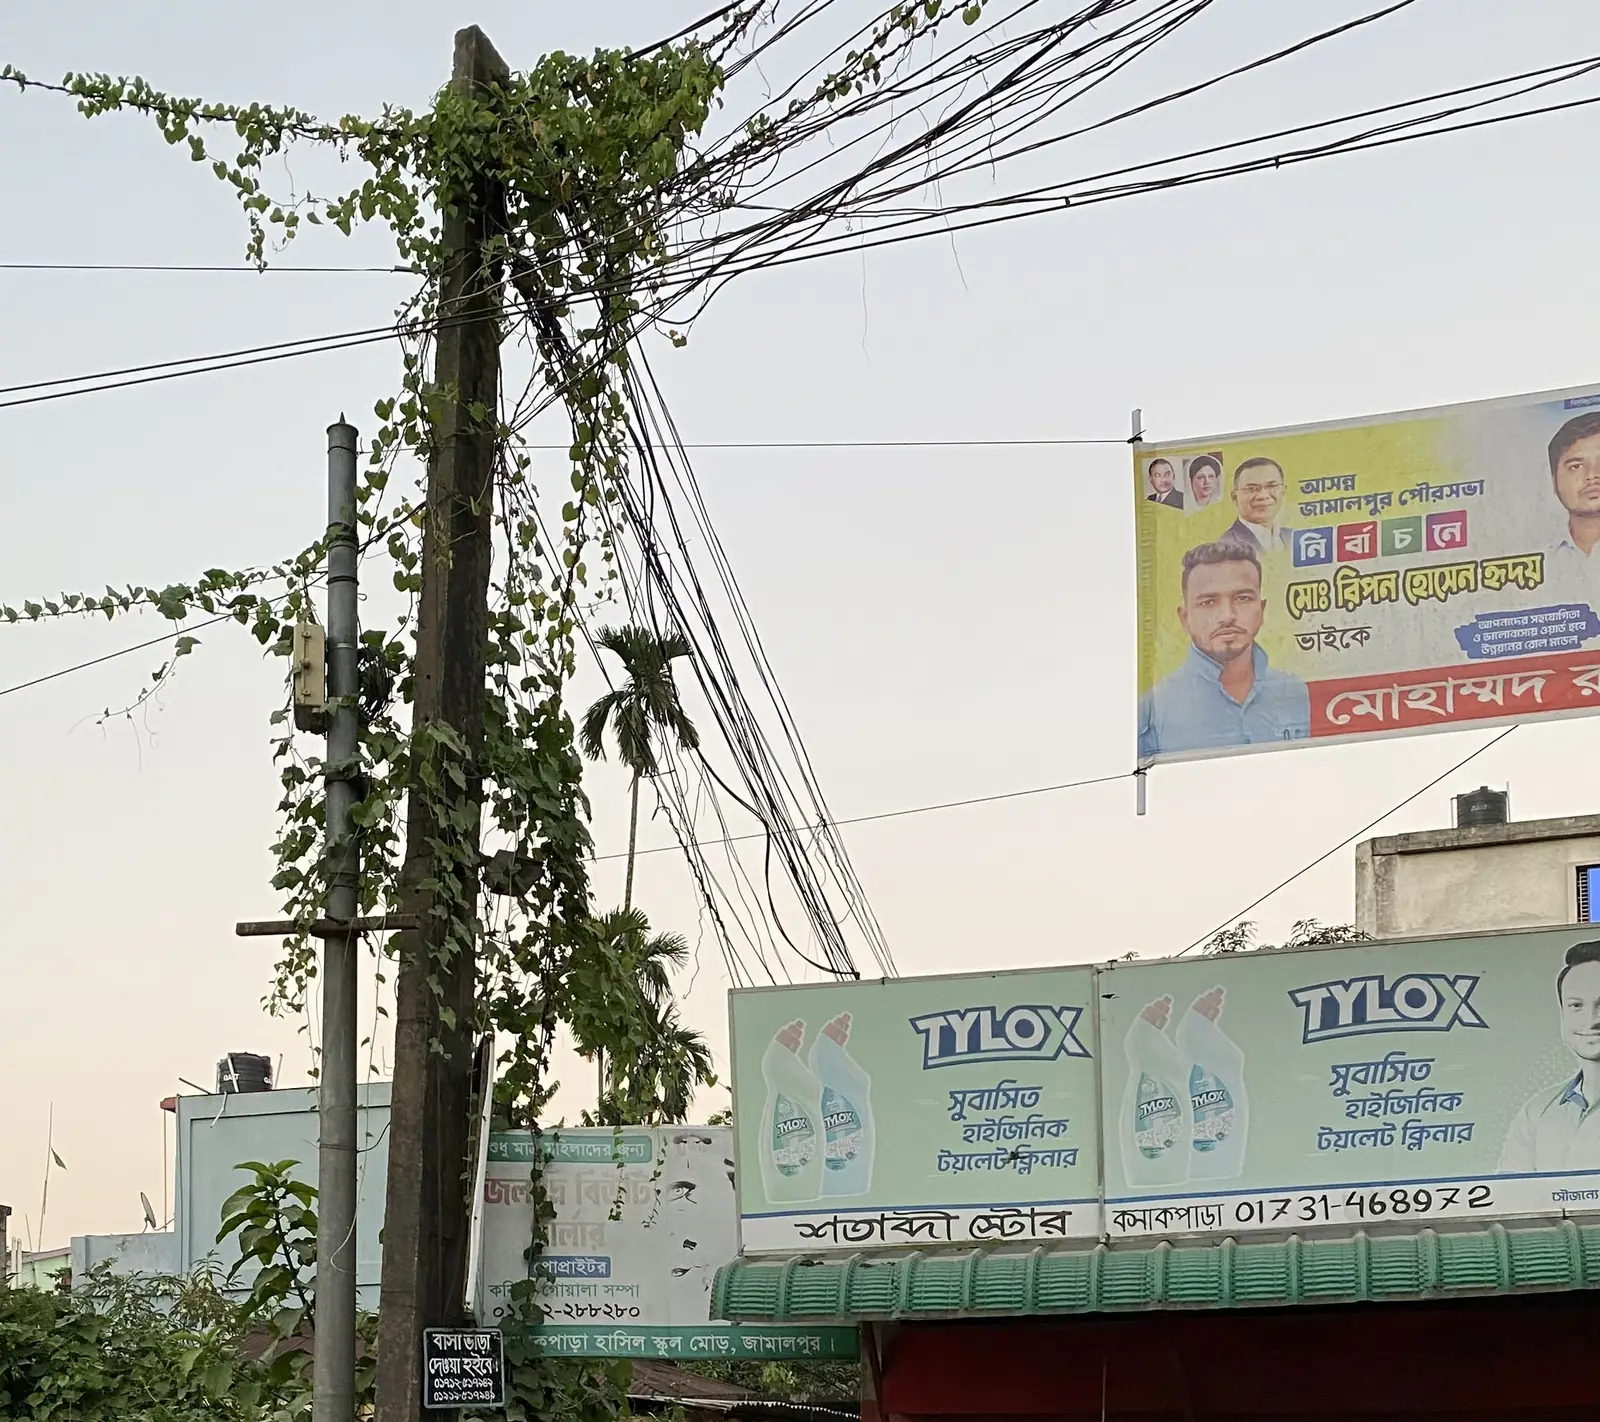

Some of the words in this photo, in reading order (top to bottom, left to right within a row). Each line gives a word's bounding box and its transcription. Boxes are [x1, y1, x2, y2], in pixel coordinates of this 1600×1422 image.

[1298, 474, 1357, 495] আসন্ন
[1298, 491, 1394, 517] জামালপুর
[1398, 479, 1485, 506] পৌরসভা
[1286, 579, 1332, 620] মোঃ
[1334, 564, 1400, 613] রিপন
[1403, 560, 1479, 607] হোসেন
[1480, 553, 1545, 591] হৃদয়
[1294, 623, 1373, 653] ভাইকে
[1478, 615, 1529, 630] আপনাদের
[1568, 621, 1587, 633] হবে
[1524, 637, 1548, 650] রোল
[1326, 668, 1557, 726] মোহাম্মদ
[1288, 972, 1490, 1044] TYLOX
[908, 1004, 1093, 1070] TYLOX
[1328, 1051, 1436, 1098] সুবাসিত
[947, 1079, 1043, 1122] সুবাসিত
[1345, 1087, 1464, 1119] হাইজিনিক
[962, 1114, 1070, 1144] হাইজিনিক
[1317, 1121, 1397, 1152] টয়লেট
[1401, 1119, 1475, 1151] ক্লিনার
[937, 1148, 1010, 1175] টয়লেট
[1011, 1144, 1079, 1175] ক্লিনার
[1235, 1185, 1494, 1223] 01731-468972
[794, 1210, 960, 1244] শতাব্দী
[969, 1207, 1073, 1240] স্টোর
[493, 1302, 641, 1321] ০১২-২৮৮২৮০
[432, 1333, 462, 1351] বাসা
[463, 1334, 491, 1355] ভাড়া
[651, 1335, 683, 1357] স্কুল
[741, 1334, 821, 1355] জামালপুর
[429, 1358, 461, 1377] দেওয়া
